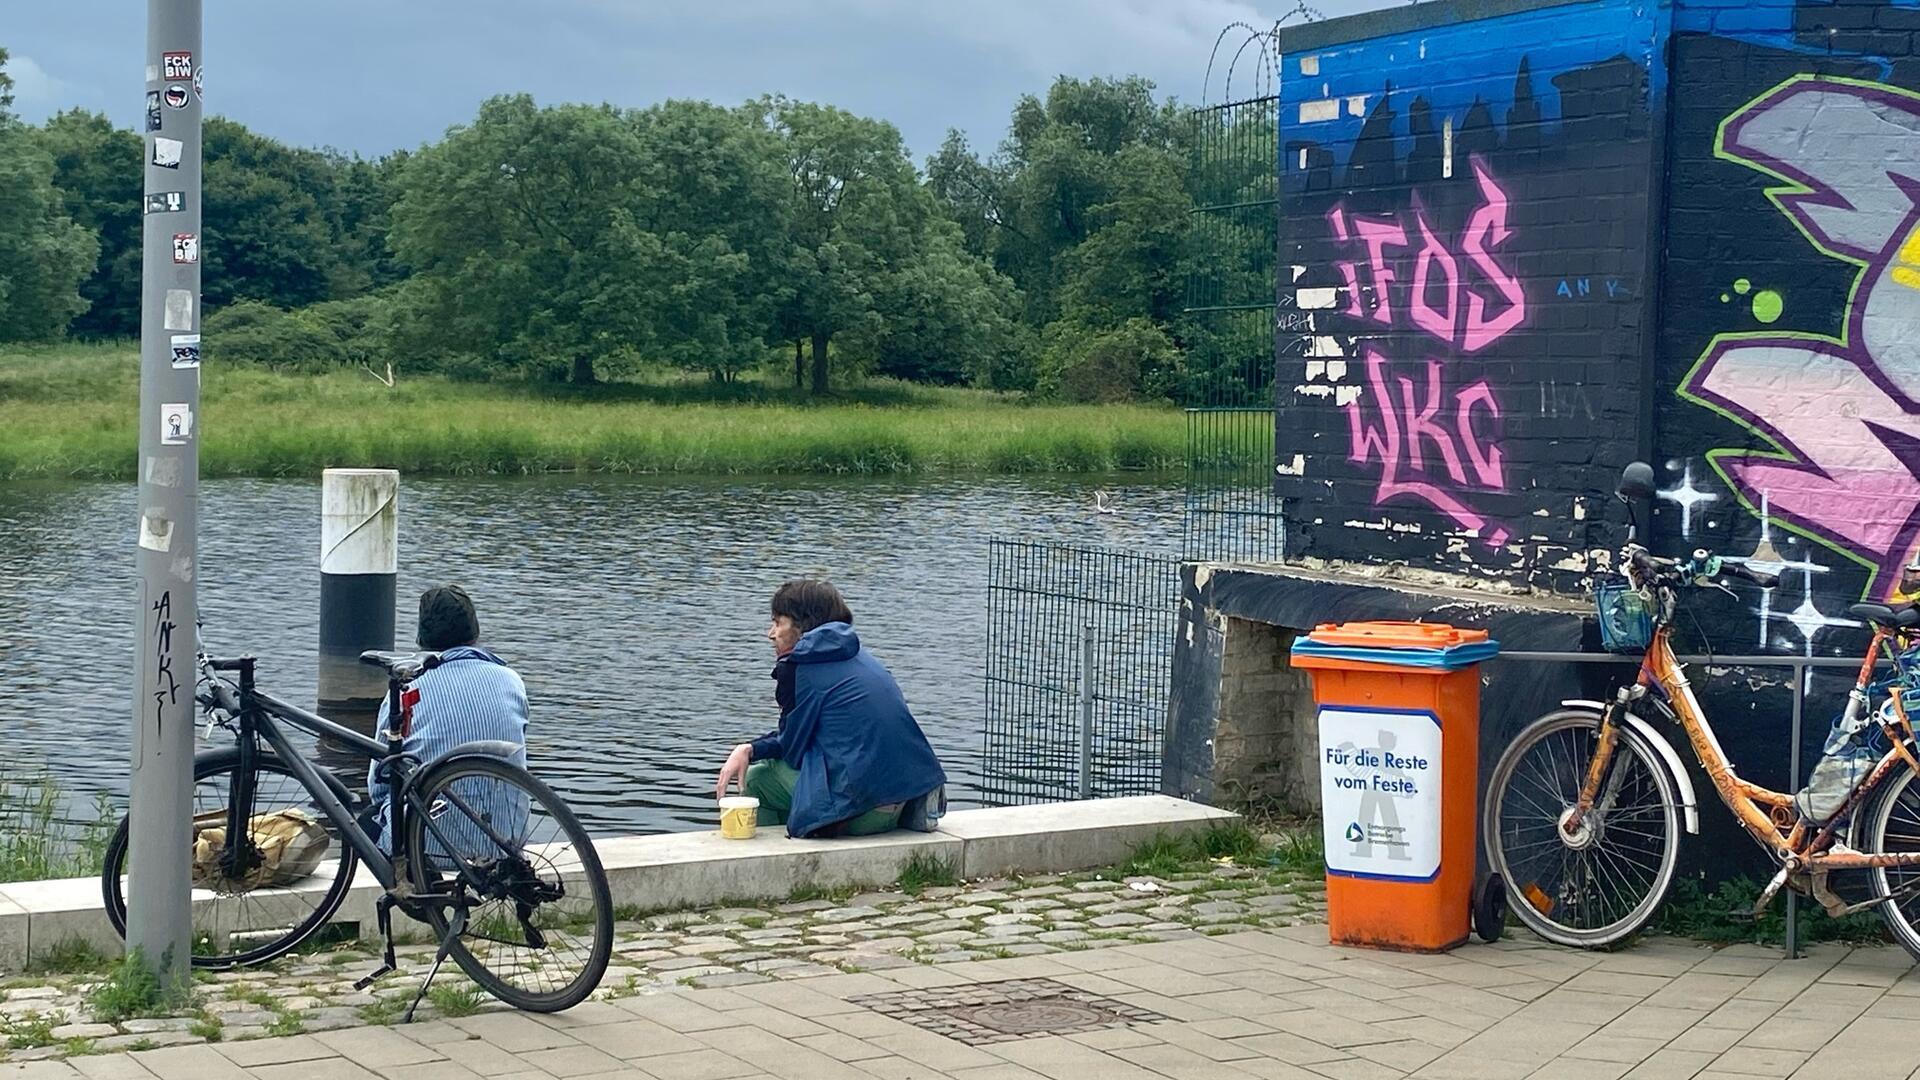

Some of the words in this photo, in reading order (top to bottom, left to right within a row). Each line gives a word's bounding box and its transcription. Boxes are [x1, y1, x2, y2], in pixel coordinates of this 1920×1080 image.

[164, 56, 191, 67] FCK
[165, 66, 192, 77] BIW
[1326, 748, 1350, 766] Für
[1355, 749, 1379, 767] die
[1385, 752, 1428, 770] Reste
[1334, 777, 1367, 790] vom
[1373, 775, 1418, 793] Feste.
